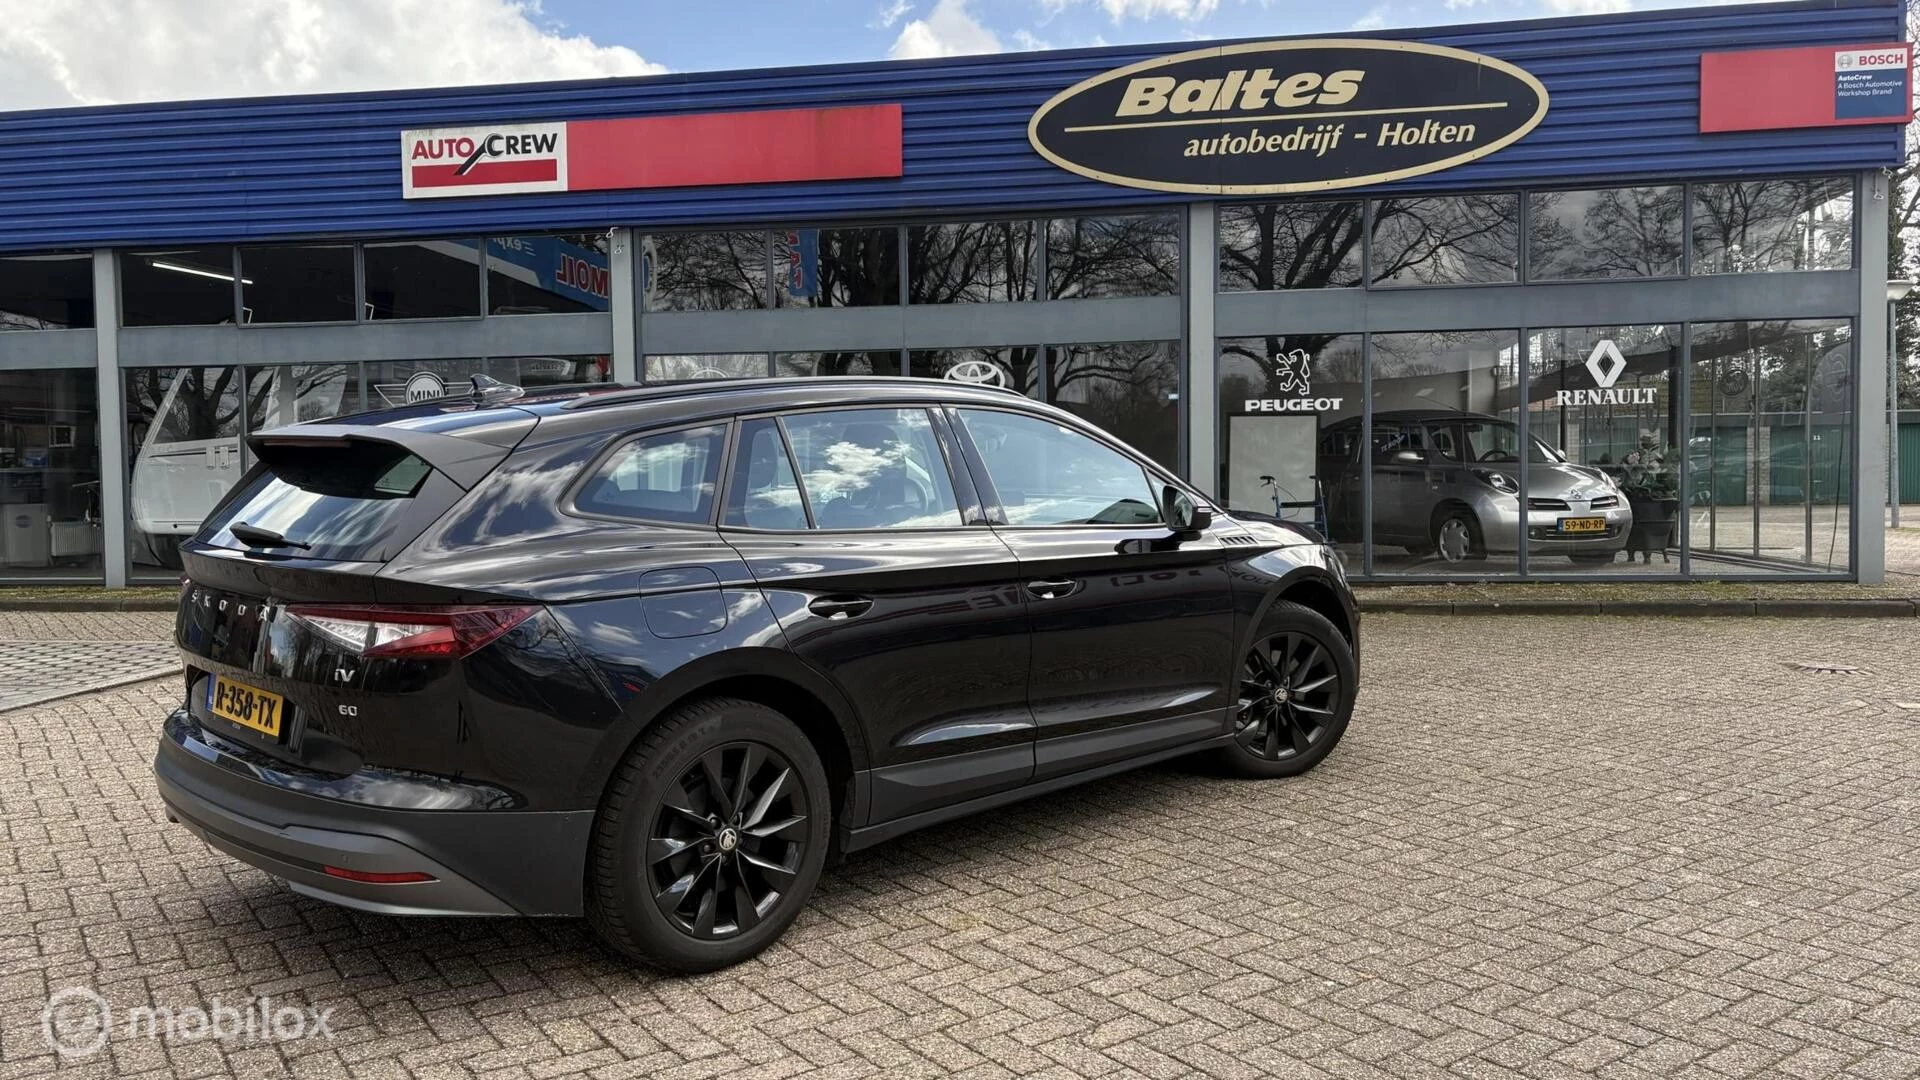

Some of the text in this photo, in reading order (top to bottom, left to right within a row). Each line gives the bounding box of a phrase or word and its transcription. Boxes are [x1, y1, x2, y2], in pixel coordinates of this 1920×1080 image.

[1858, 53, 1904, 66] BOSCH
[1837, 74, 1873, 82] AutoCrew
[1865, 80, 1903, 88] Automotive
[1115, 69, 1365, 118] Baltes
[1837, 89, 1871, 97] Workshop
[1183, 123, 1346, 158] autobedrijf
[1377, 118, 1477, 148] Holten
[412, 132, 558, 160] AUTO CREW
[410, 389, 440, 401] MINI
[1556, 387, 1657, 406] RENAULT
[1244, 397, 1344, 412] PEUGEOT
[1565, 519, 1604, 530] 59-ND-RP
[215, 681, 277, 729] R-358-TX
[338, 704, 358, 717] 60
